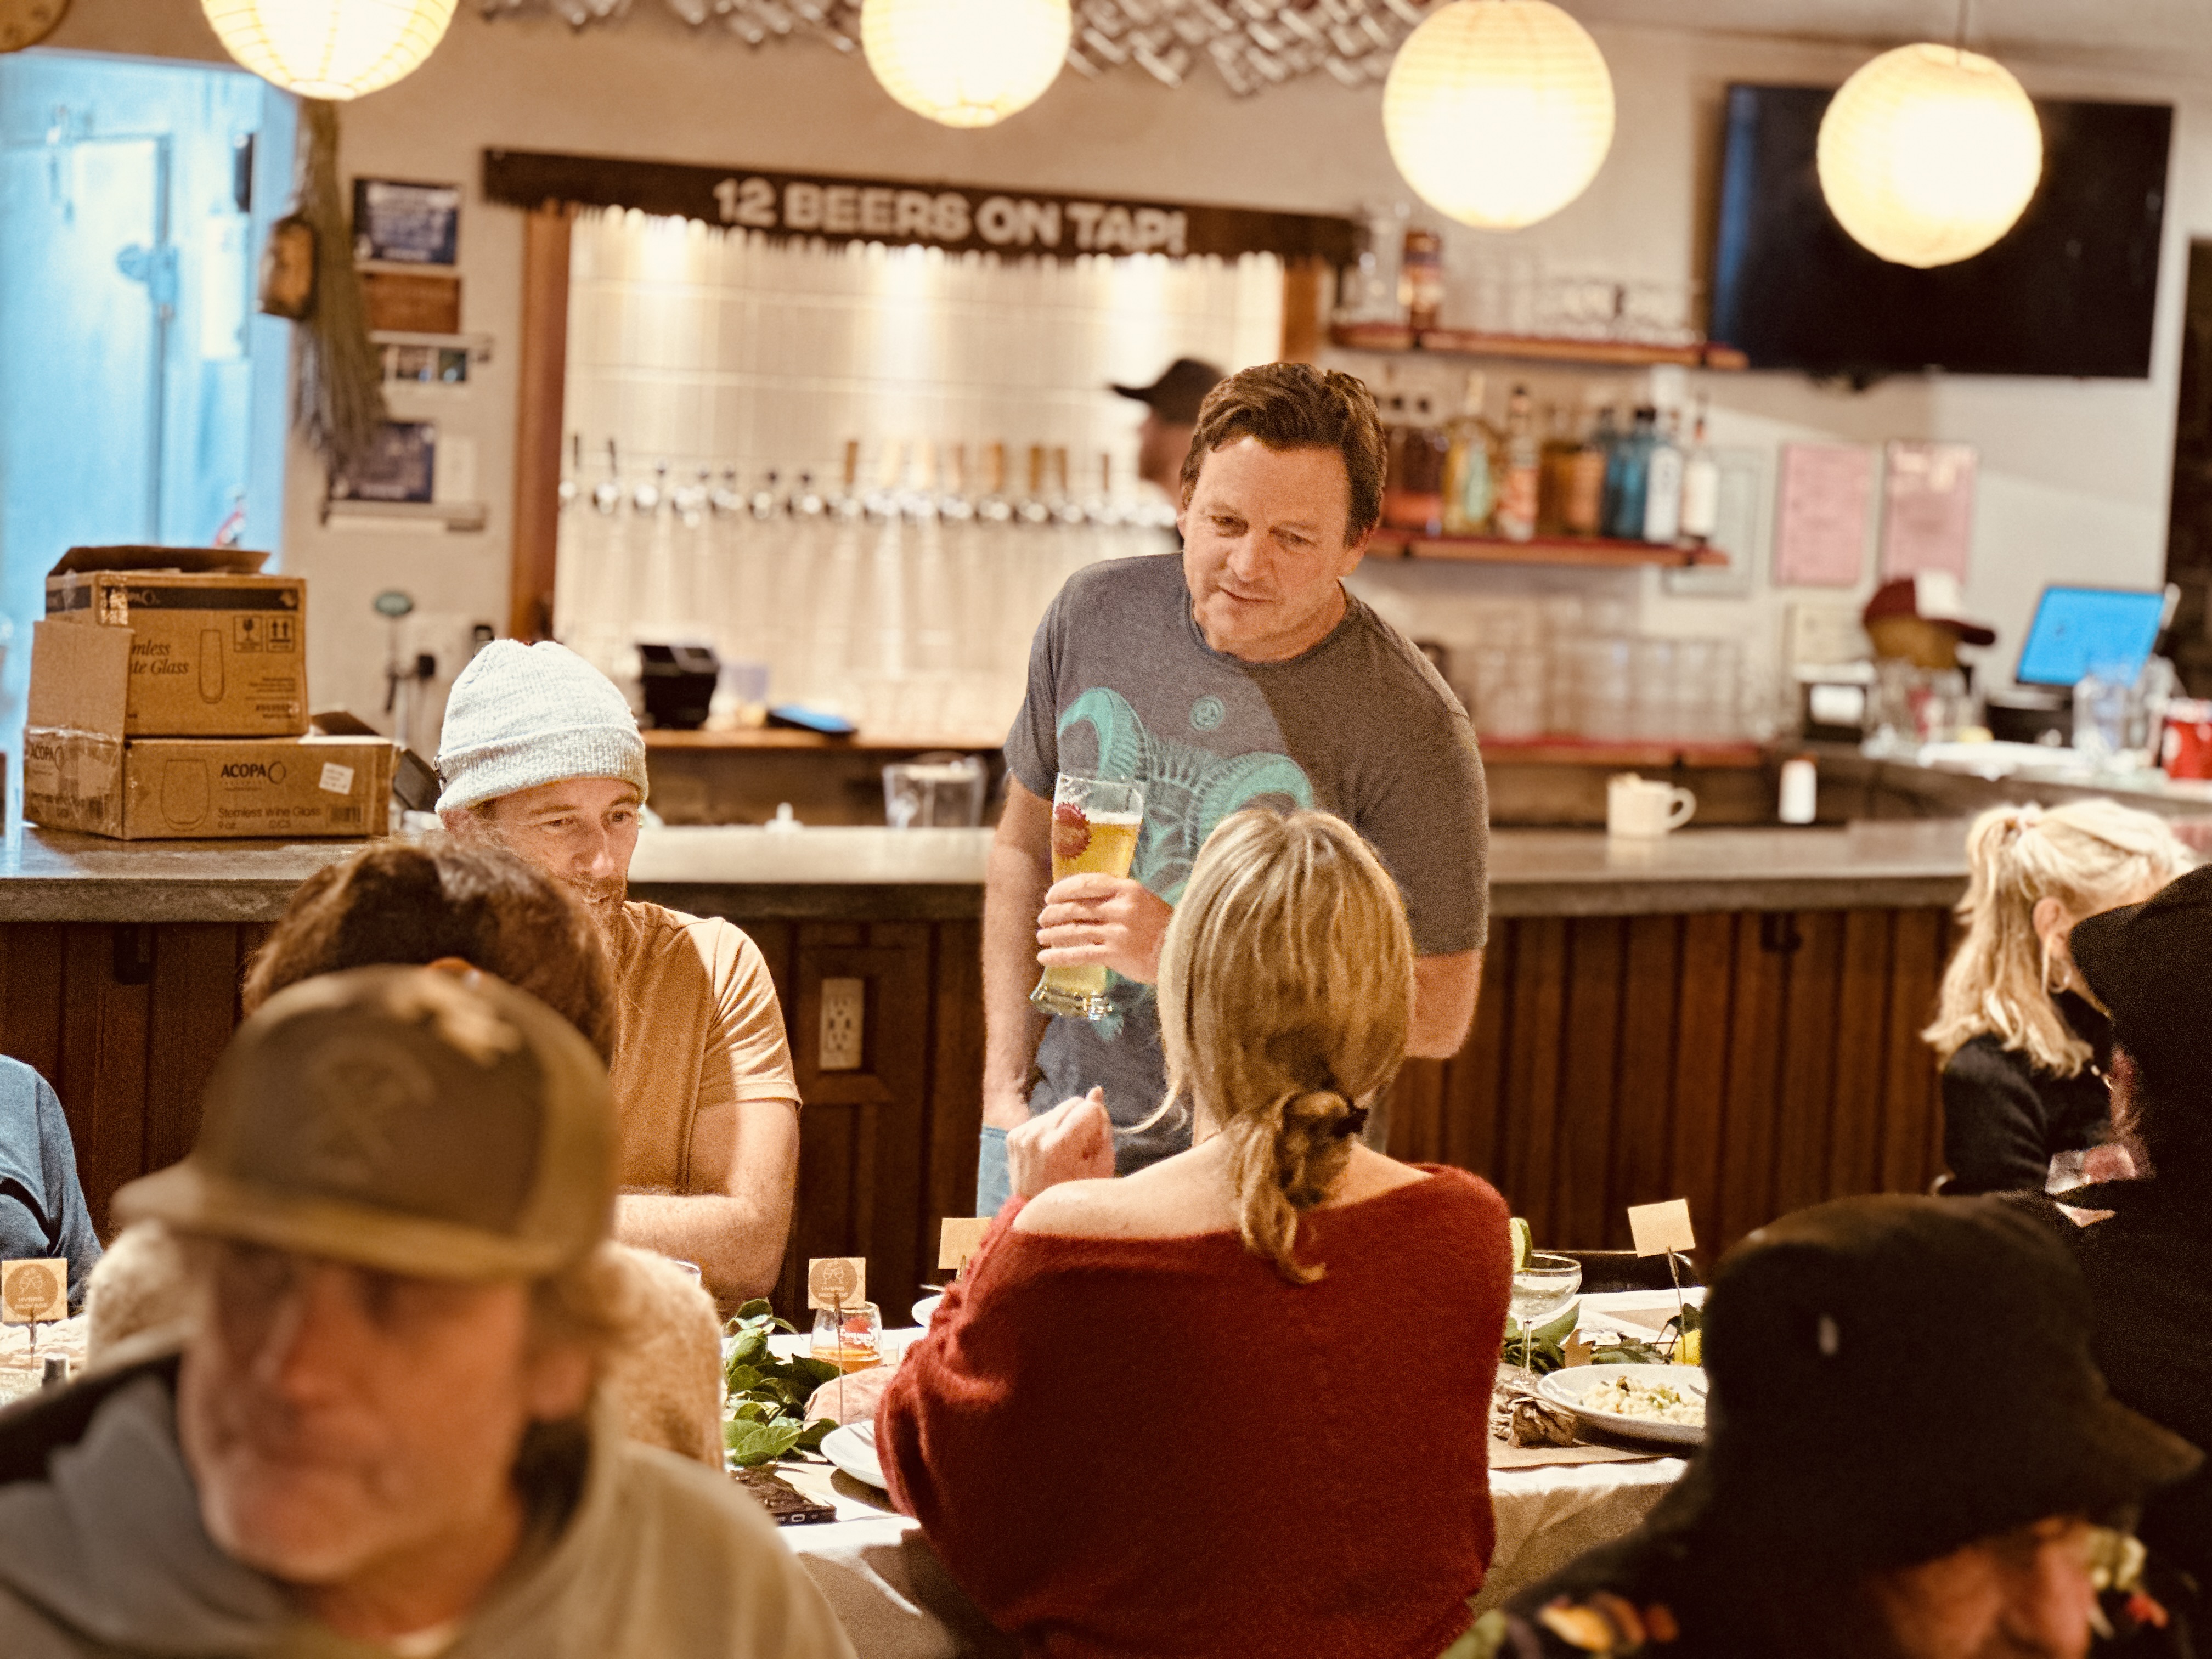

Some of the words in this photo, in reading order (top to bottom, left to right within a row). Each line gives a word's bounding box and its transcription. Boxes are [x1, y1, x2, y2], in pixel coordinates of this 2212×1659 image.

[713, 177, 776, 228] 12
[783, 183, 973, 241] BEERS
[977, 196, 1062, 247] ON
[1065, 201, 1188, 256] TAP!
[151, 659, 189, 675] Glass
[31, 744, 55, 761] ACOPA
[221, 763, 267, 778] ACOPA
[218, 806, 262, 819] Stemless
[266, 807, 290, 817] Wine
[293, 806, 321, 817] Glass
